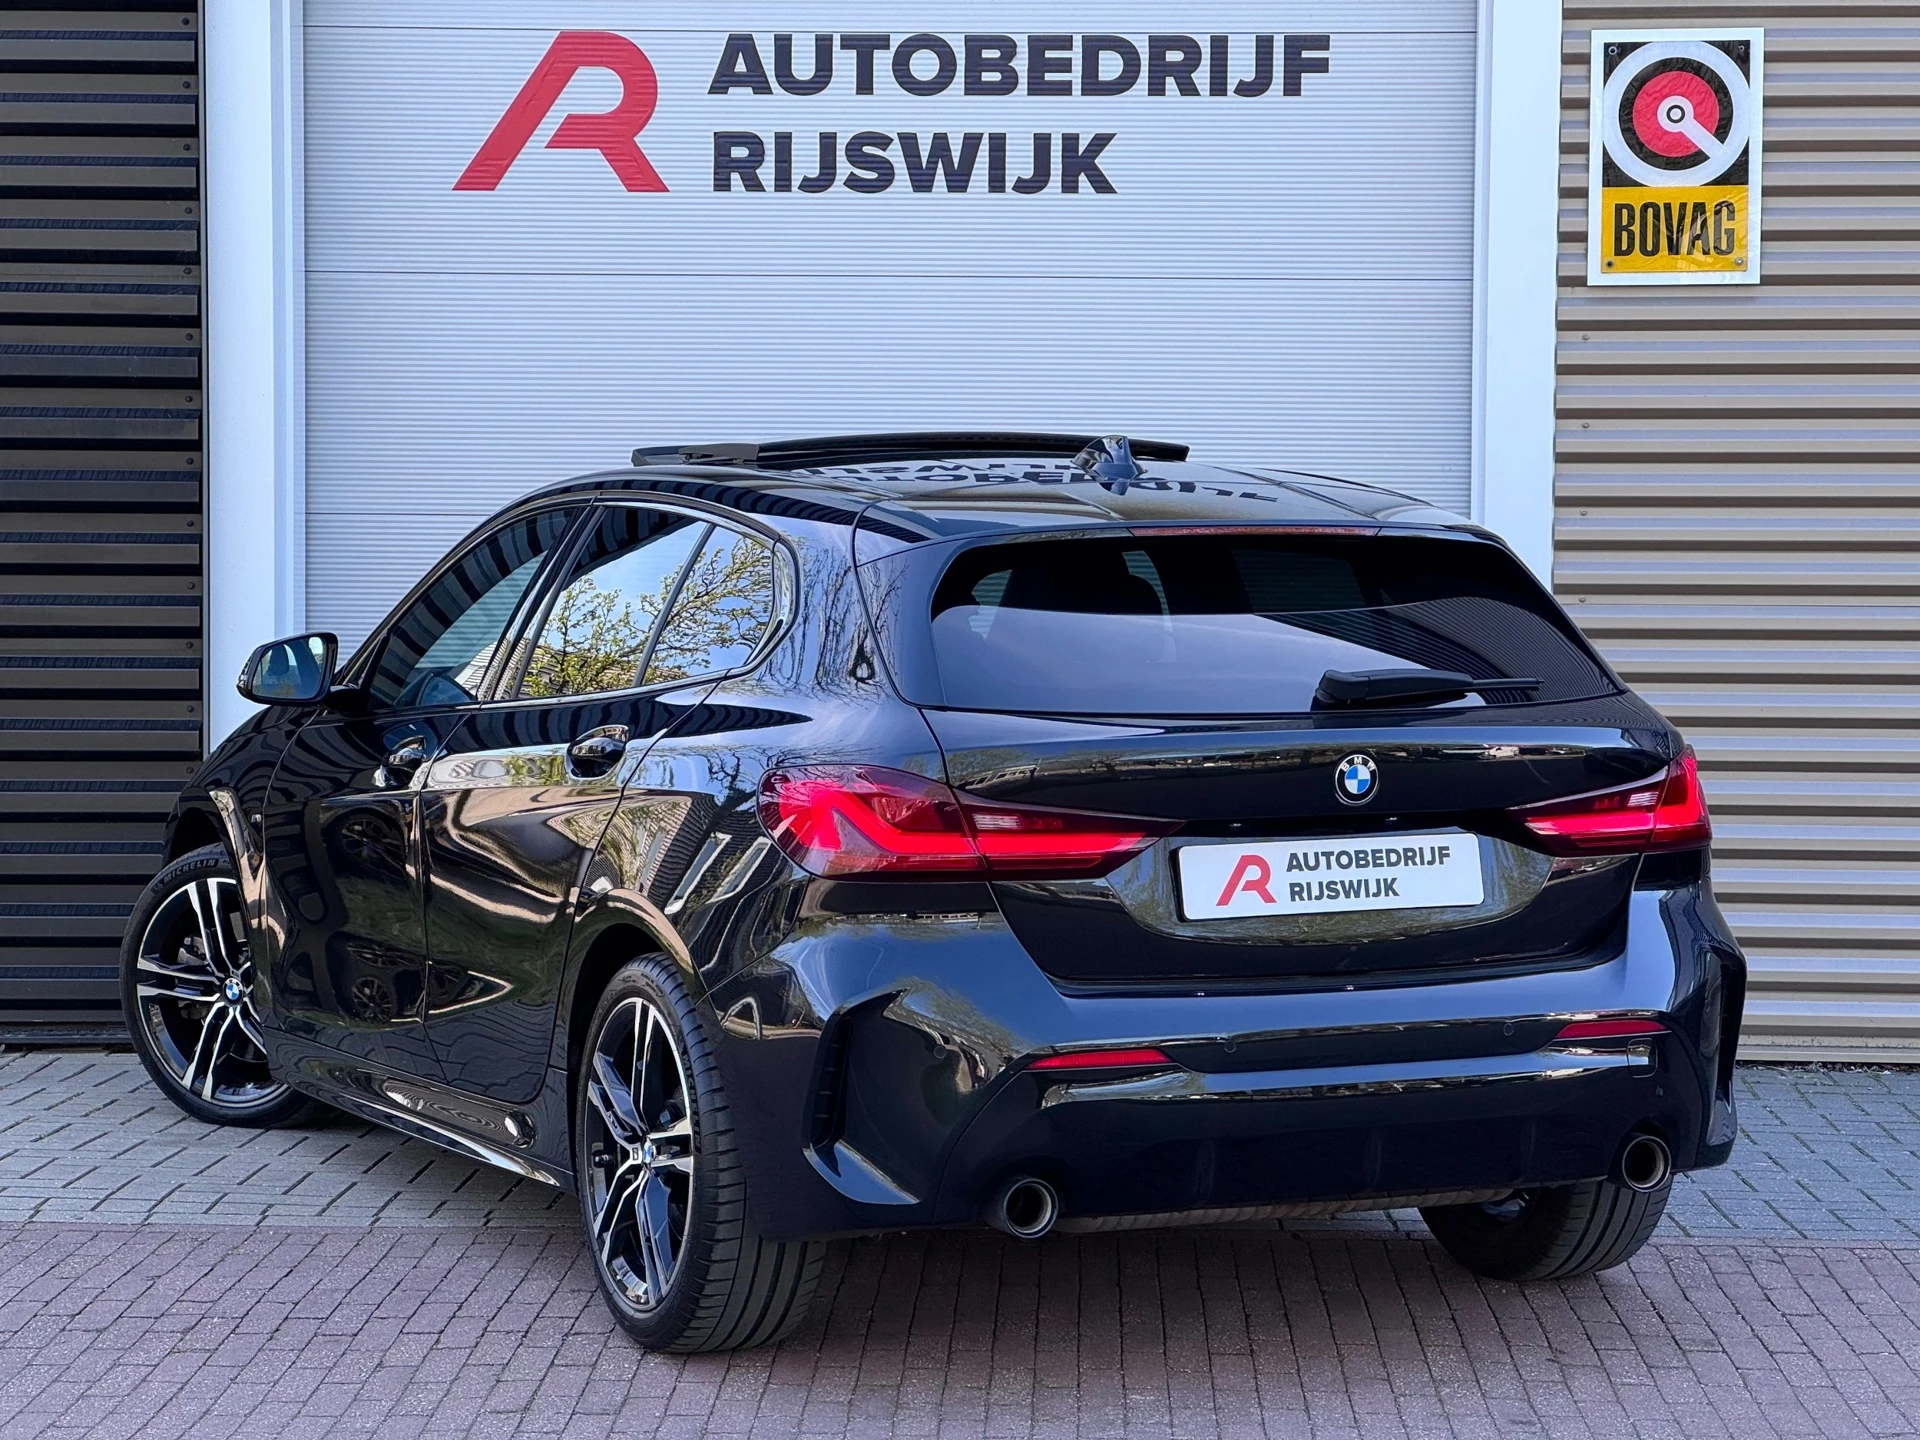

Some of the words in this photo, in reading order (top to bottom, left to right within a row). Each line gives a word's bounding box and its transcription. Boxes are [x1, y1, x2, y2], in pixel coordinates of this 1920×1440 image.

[708, 34, 1331, 97] AUTOBEDRIJF
[713, 131, 1118, 194] RIJSWIJK
[1613, 200, 1736, 258] BOVAG
[1340, 756, 1376, 772] BMW
[163, 858, 217, 885] MICHELIN
[1286, 846, 1451, 873] AUTOBEDRIJF
[1289, 877, 1400, 902] RIJSWIJK
